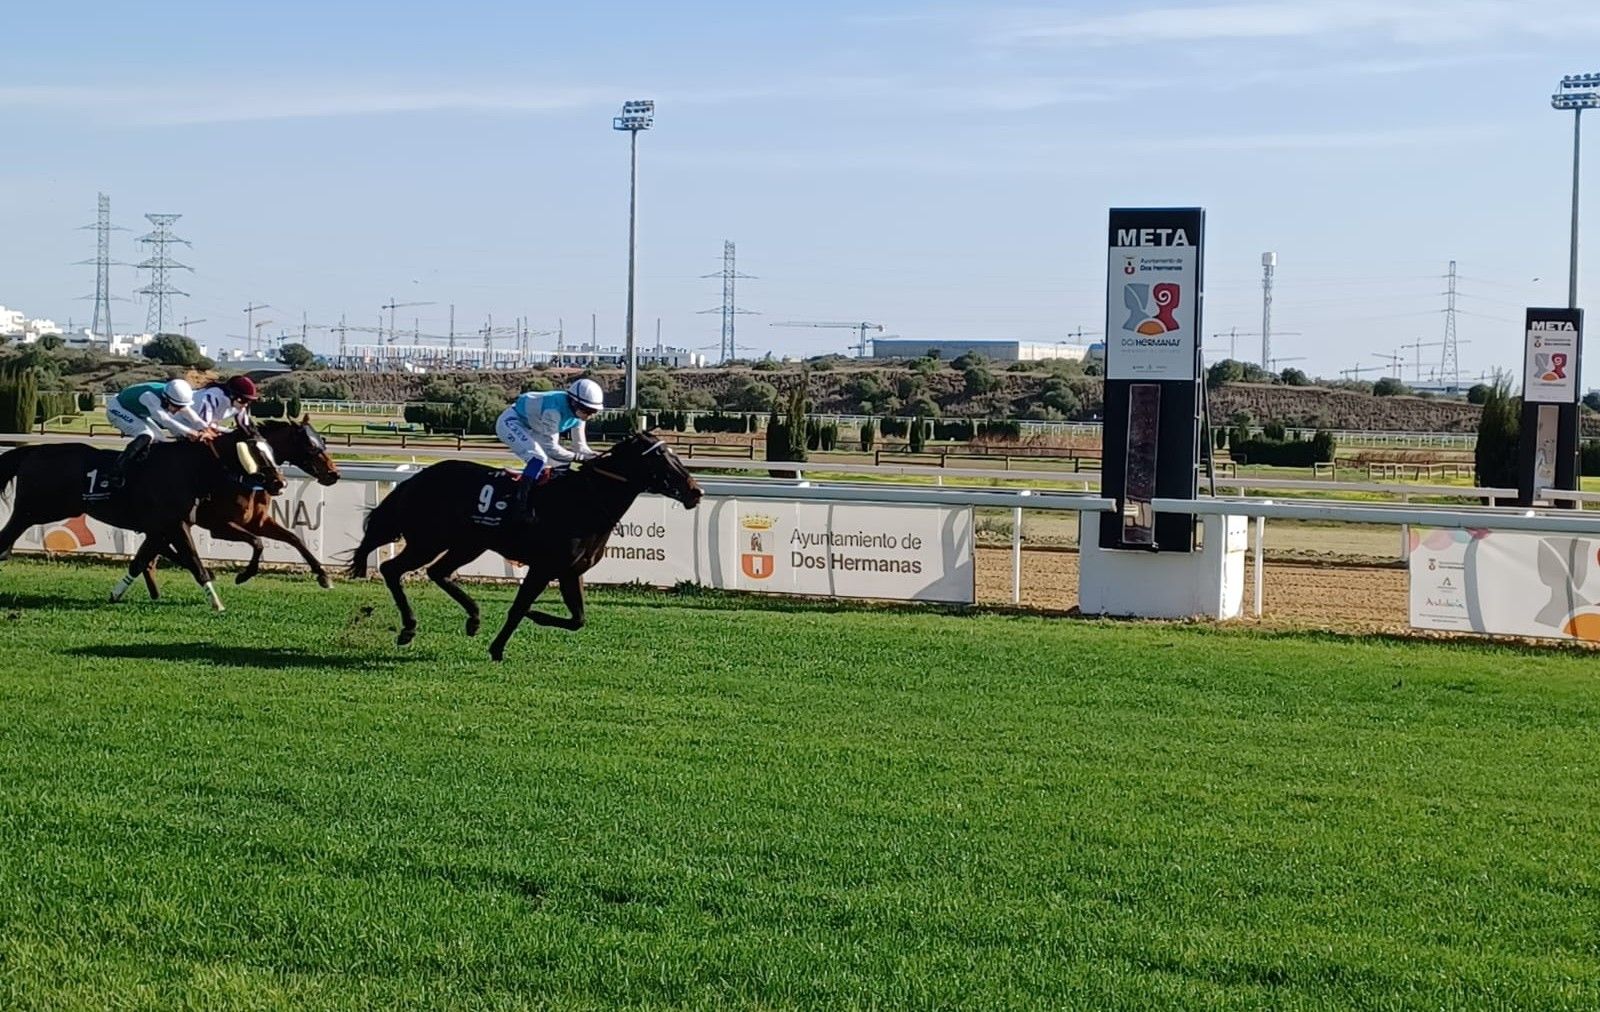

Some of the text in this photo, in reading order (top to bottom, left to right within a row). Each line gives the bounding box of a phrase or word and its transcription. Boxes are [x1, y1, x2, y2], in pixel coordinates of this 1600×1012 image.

[1117, 228, 1190, 247] META
[1531, 320, 1575, 332] META
[86, 468, 98, 494] 1
[477, 484, 495, 513] 9
[271, 499, 325, 531] NAS
[646, 522, 666, 538] de
[790, 527, 922, 551] Ayuntamiento de
[605, 545, 666, 561] rmanas
[791, 552, 922, 574] Dos Hermanas
